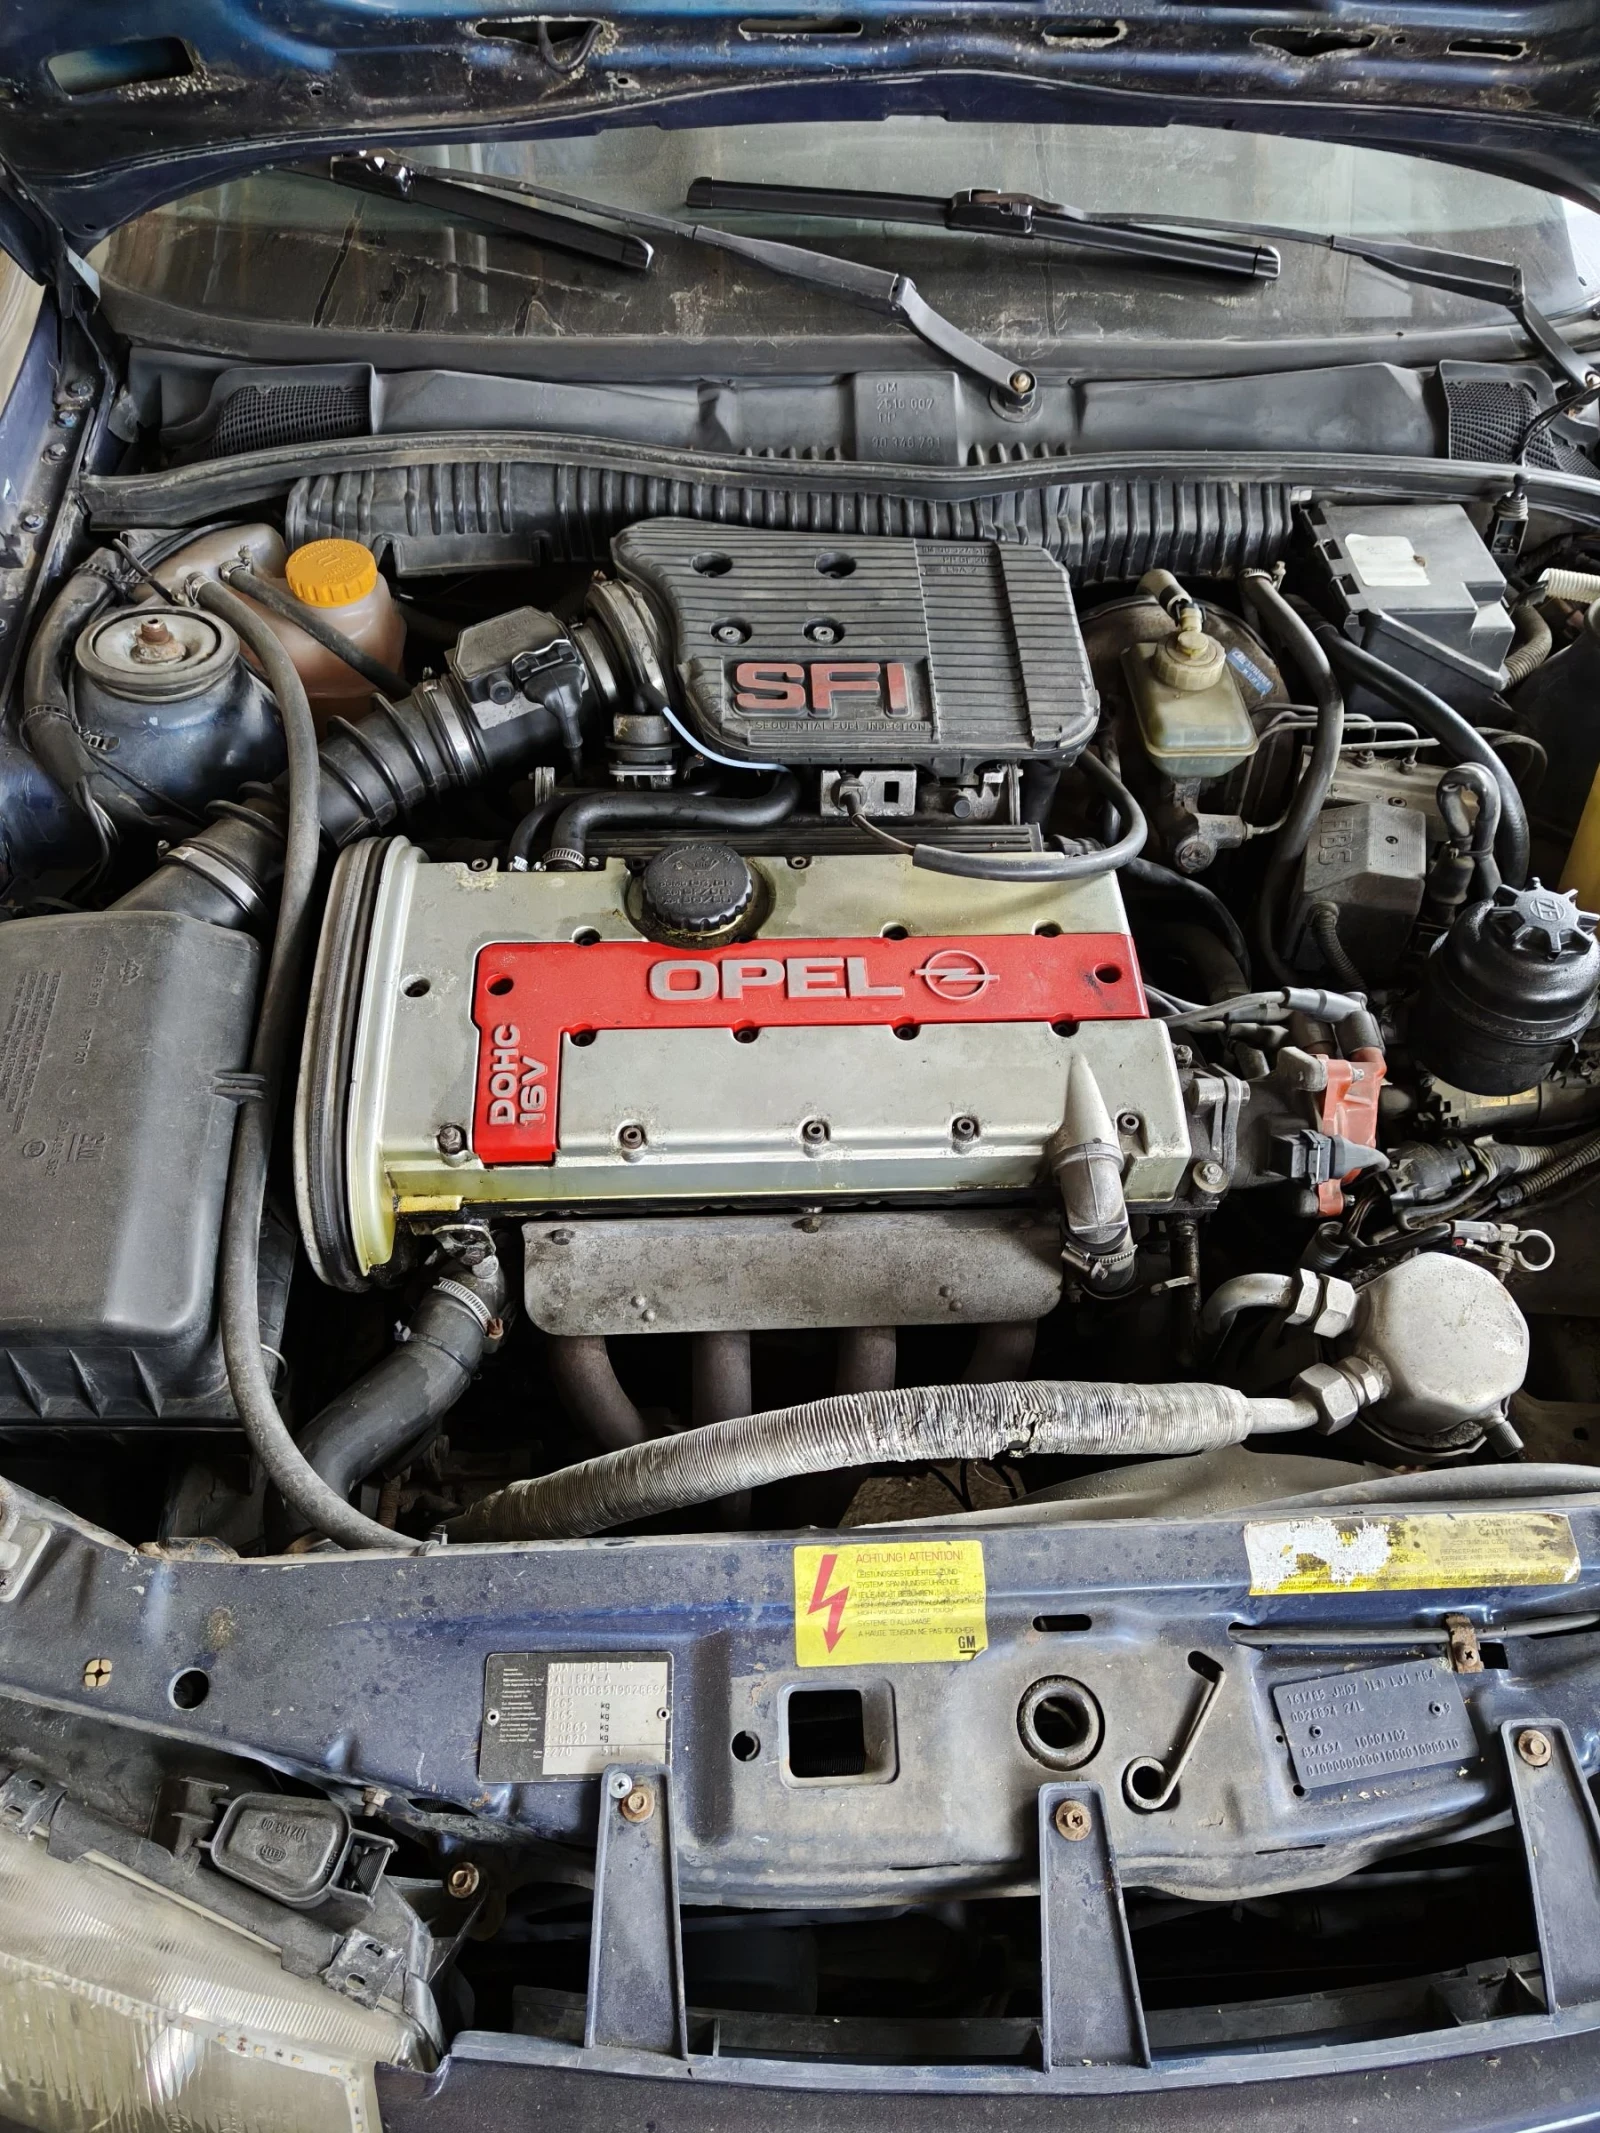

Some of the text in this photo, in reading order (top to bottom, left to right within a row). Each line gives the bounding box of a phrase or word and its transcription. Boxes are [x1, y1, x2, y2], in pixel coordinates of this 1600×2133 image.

[734, 661, 912, 715] SFI
[755, 721, 927, 732] SEQUENTIAL FUEL INJECTION
[648, 956, 905, 1002] OPEL
[489, 1024, 520, 1127] DOHC
[518, 1056, 548, 1124] 16V
[958, 1636, 976, 1649] GM
[601, 1702, 610, 1711] kg
[600, 1713, 610, 1721] kg
[600, 1723, 609, 1732] kg
[600, 1734, 609, 1743] kg
